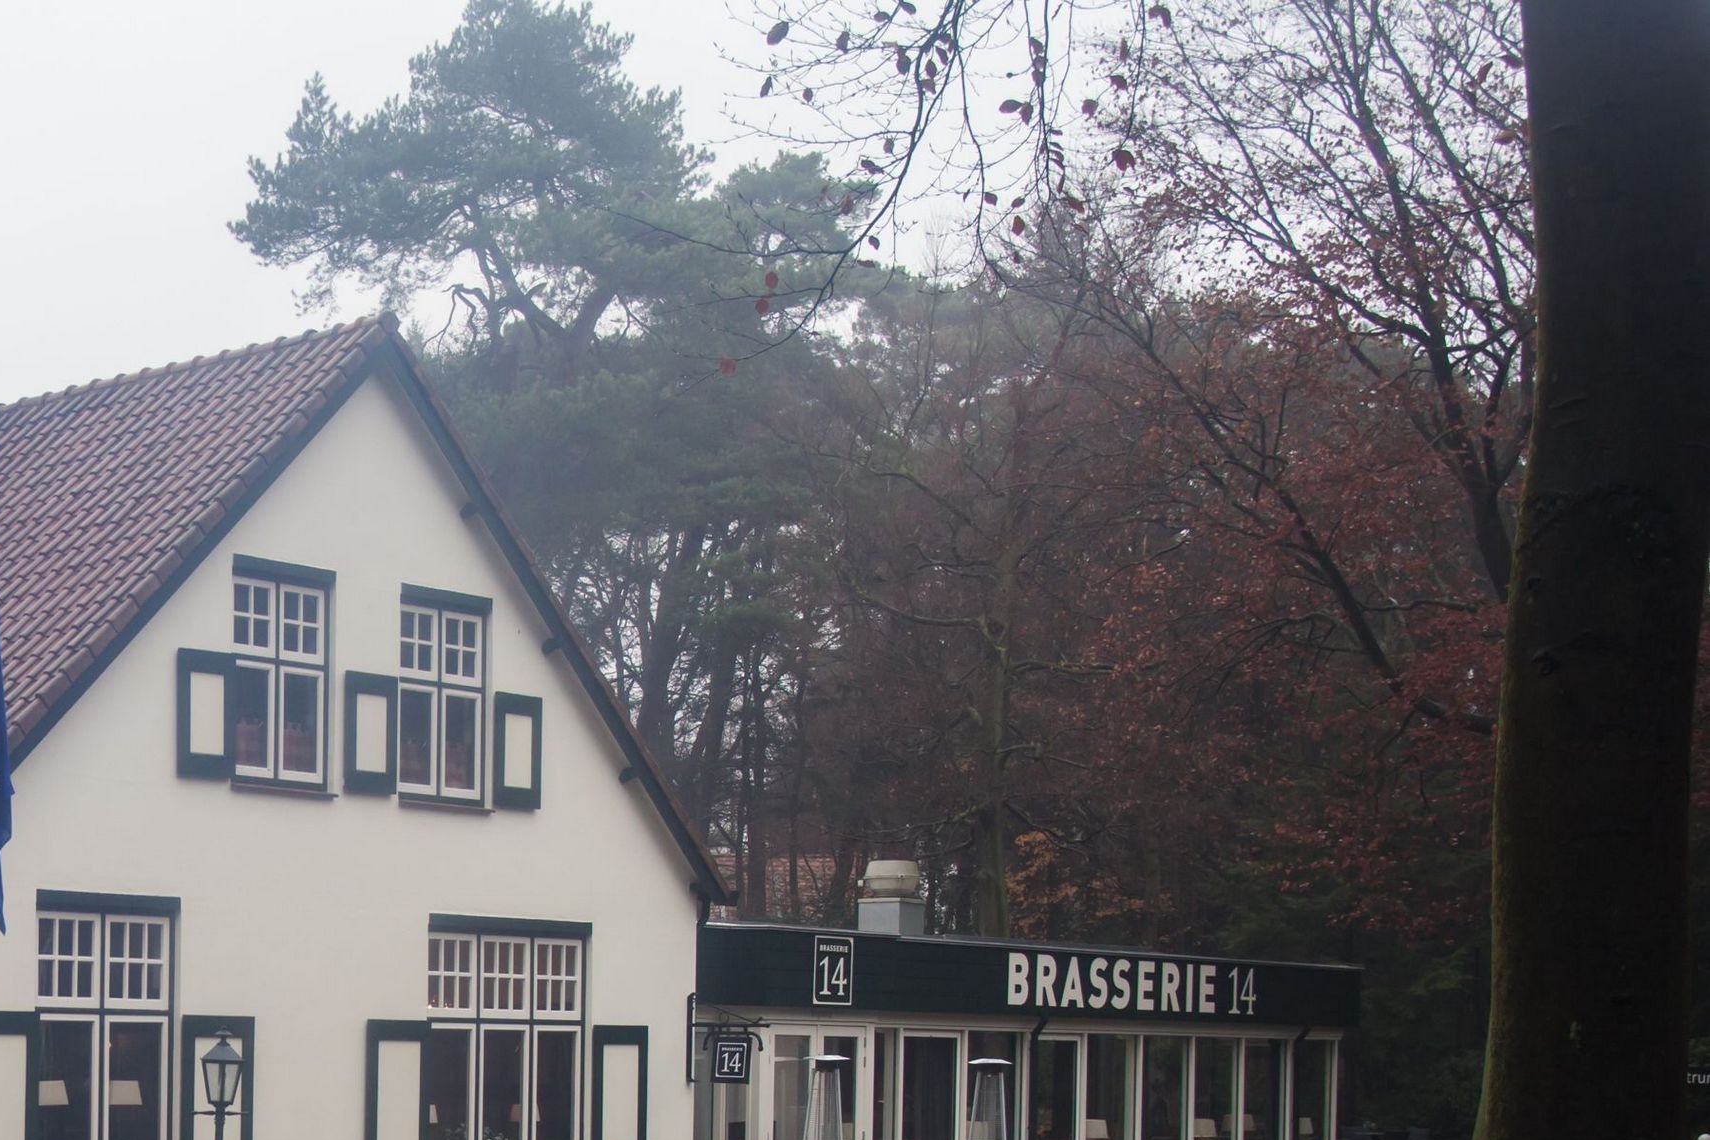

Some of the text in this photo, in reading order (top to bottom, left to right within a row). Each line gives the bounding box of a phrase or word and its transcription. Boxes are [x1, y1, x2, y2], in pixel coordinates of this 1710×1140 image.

[819, 955, 847, 996] 14
[1007, 952, 1257, 1015] BRASSERIE 14
[720, 1052, 742, 1073] 14
